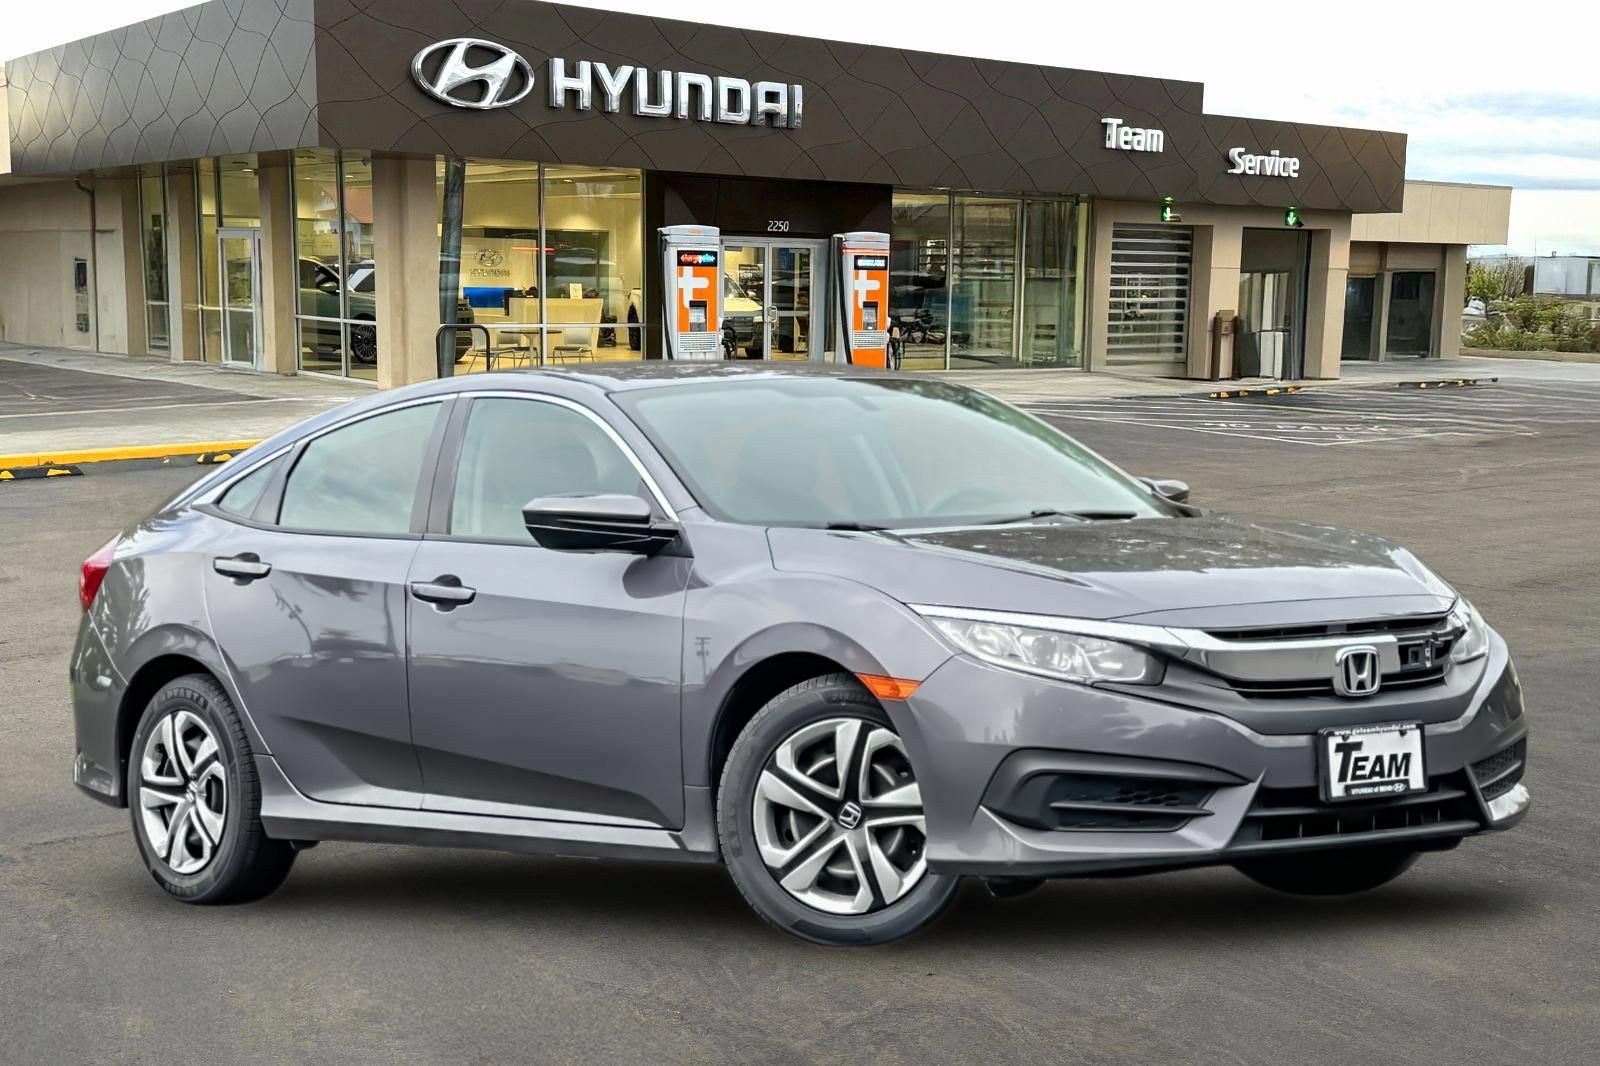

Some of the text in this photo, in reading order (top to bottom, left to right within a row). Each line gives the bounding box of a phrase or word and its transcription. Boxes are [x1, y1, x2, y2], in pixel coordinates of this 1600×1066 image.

[549, 57, 803, 129] HYUNDAI
[1100, 117, 1164, 153] Team
[1227, 147, 1300, 178] Service
[767, 220, 790, 232] 2250
[1334, 741, 1411, 783] TEAM
